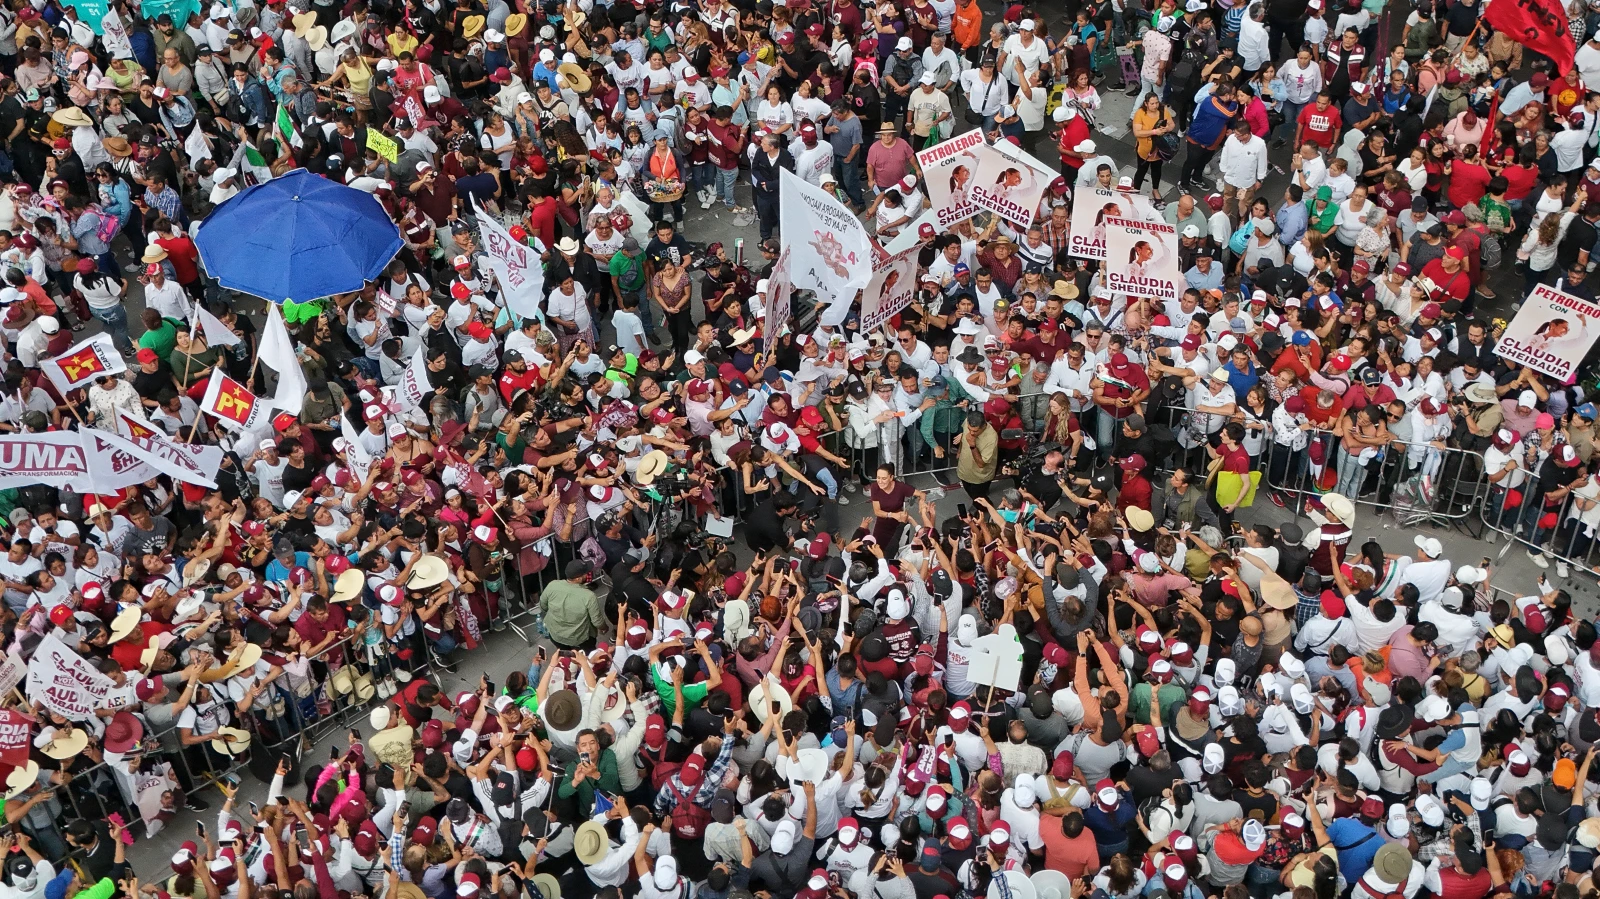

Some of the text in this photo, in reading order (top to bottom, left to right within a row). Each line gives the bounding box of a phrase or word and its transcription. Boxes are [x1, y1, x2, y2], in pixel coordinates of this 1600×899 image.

[920, 131, 983, 166] PETROLEROS
[940, 156, 956, 167] CON
[973, 186, 1030, 218] CLAUDIA
[1095, 189, 1113, 197] CON
[939, 205, 981, 226] SHEIBA
[970, 193, 1030, 225] SHEIBAUM
[1106, 216, 1175, 234] PETROLEROS
[872, 243, 926, 272] ETROLEROS
[880, 263, 893, 273] CON
[1109, 273, 1174, 290] CLAUDIA
[1109, 282, 1175, 299] SHEIBAUM
[862, 289, 912, 324] CLAUDIA
[862, 296, 912, 331] SHEIBAUM
[1535, 286, 1600, 320] PETROLERO
[1549, 304, 1568, 314] CON
[1498, 346, 1568, 378] SHEIBAUM
[1503, 337, 1571, 370] CLAUDIA
[65, 357, 95, 381] PT
[216, 392, 250, 419] PT
